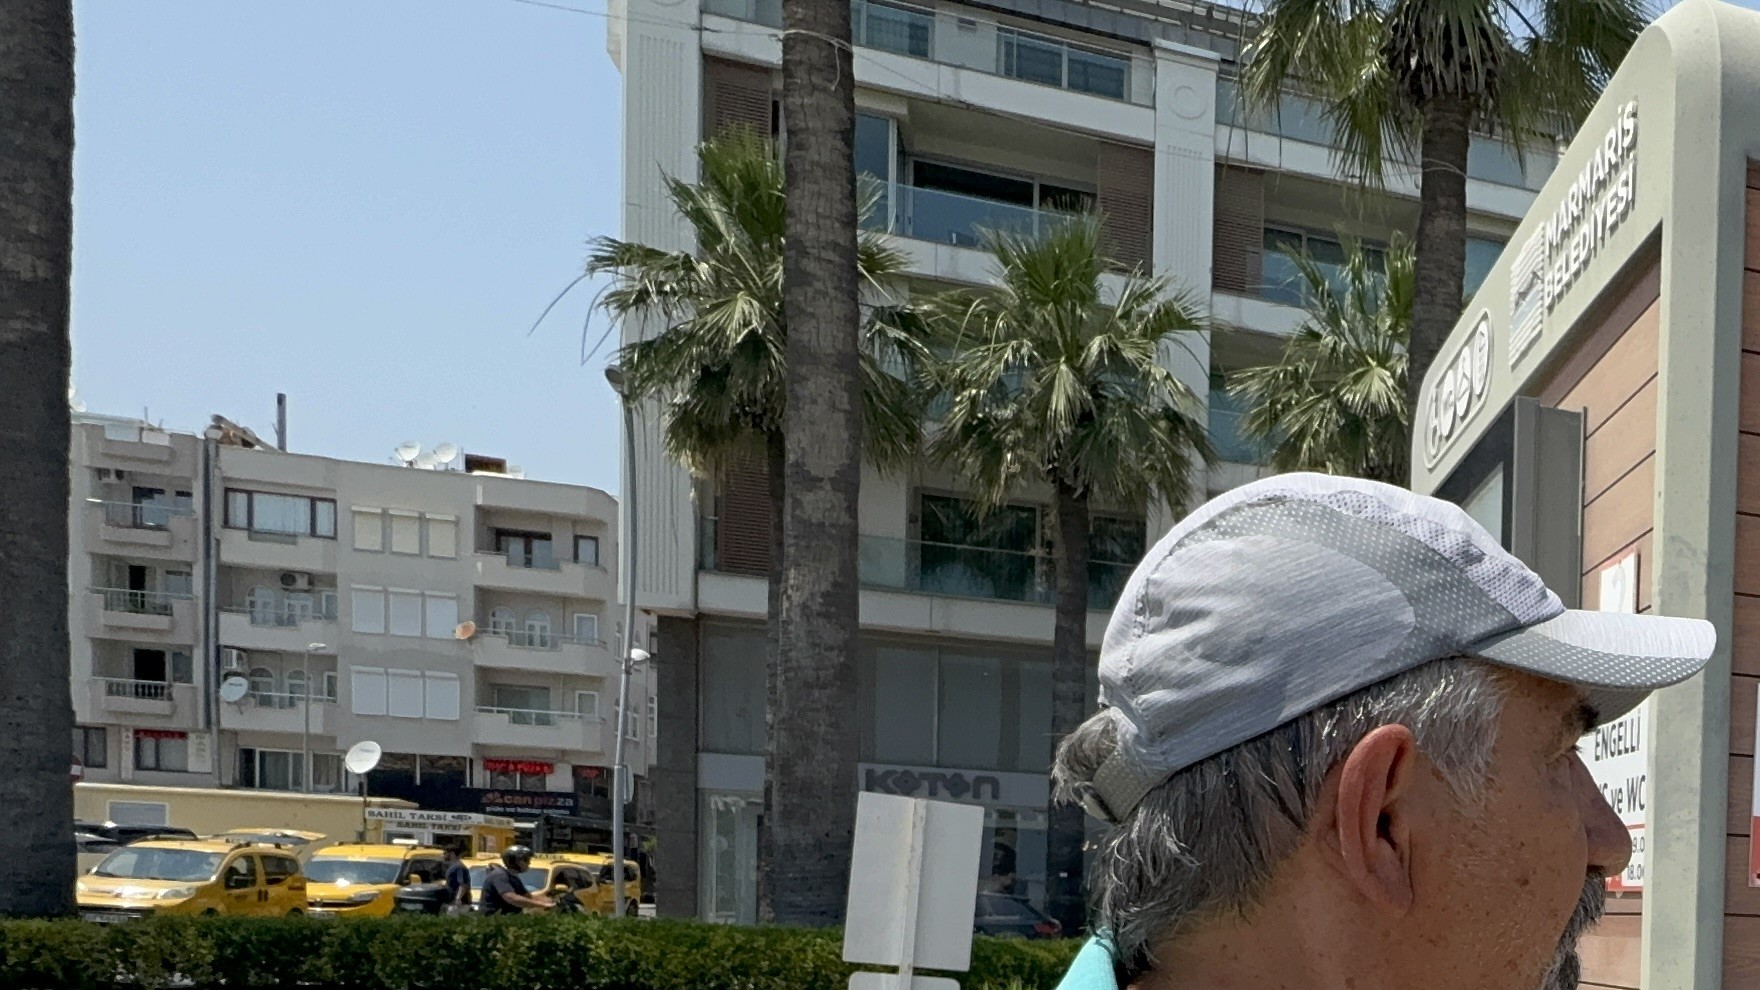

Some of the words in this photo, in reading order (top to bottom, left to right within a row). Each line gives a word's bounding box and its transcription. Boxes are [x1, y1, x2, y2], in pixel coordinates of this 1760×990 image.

[1545, 151, 1636, 310] BELEDİYESİ
[1546, 98, 1637, 257] MARMARİS
[1594, 708, 1641, 762] ENGELLİ
[1626, 775, 1646, 814] WC
